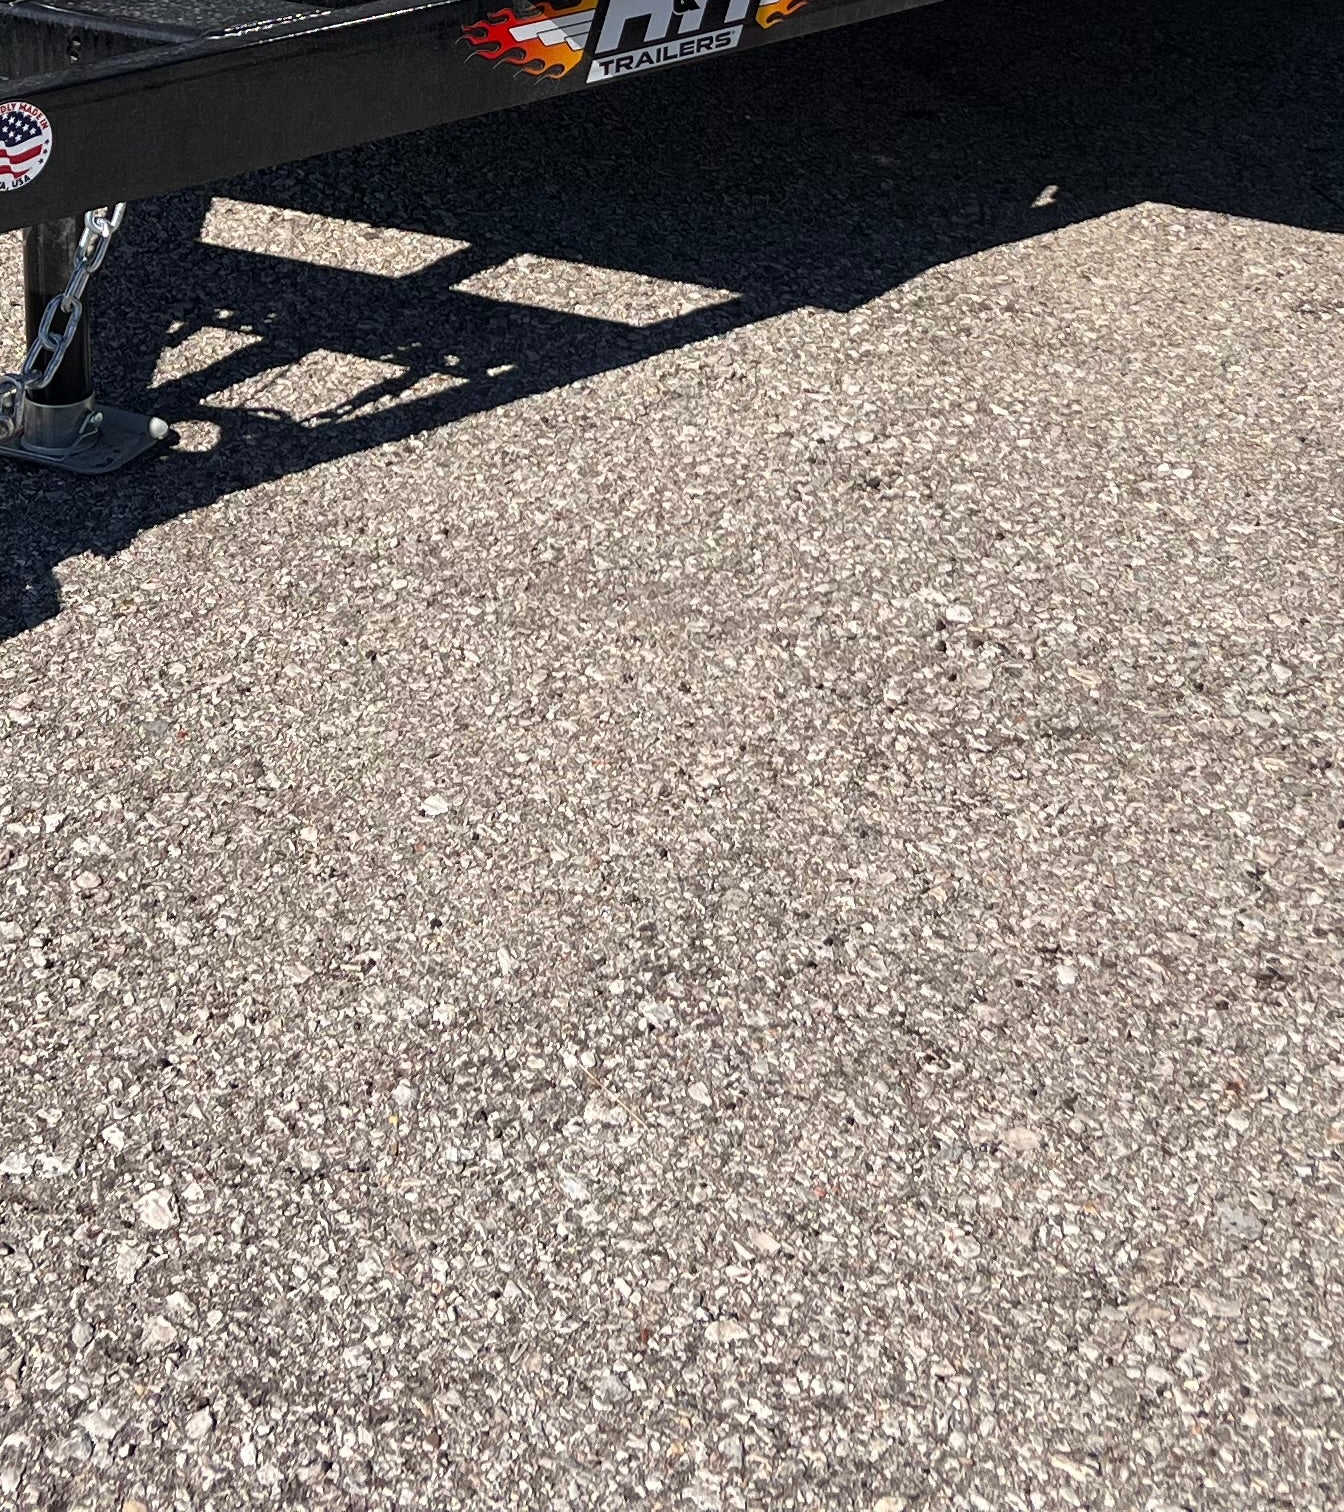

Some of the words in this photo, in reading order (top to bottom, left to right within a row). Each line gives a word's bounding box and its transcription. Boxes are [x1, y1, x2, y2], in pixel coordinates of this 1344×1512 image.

[599, 30, 732, 76] TRAILERS
[19, 103, 43, 121] MADE
[39, 119, 49, 130] IN
[11, 174, 31, 188] USA
